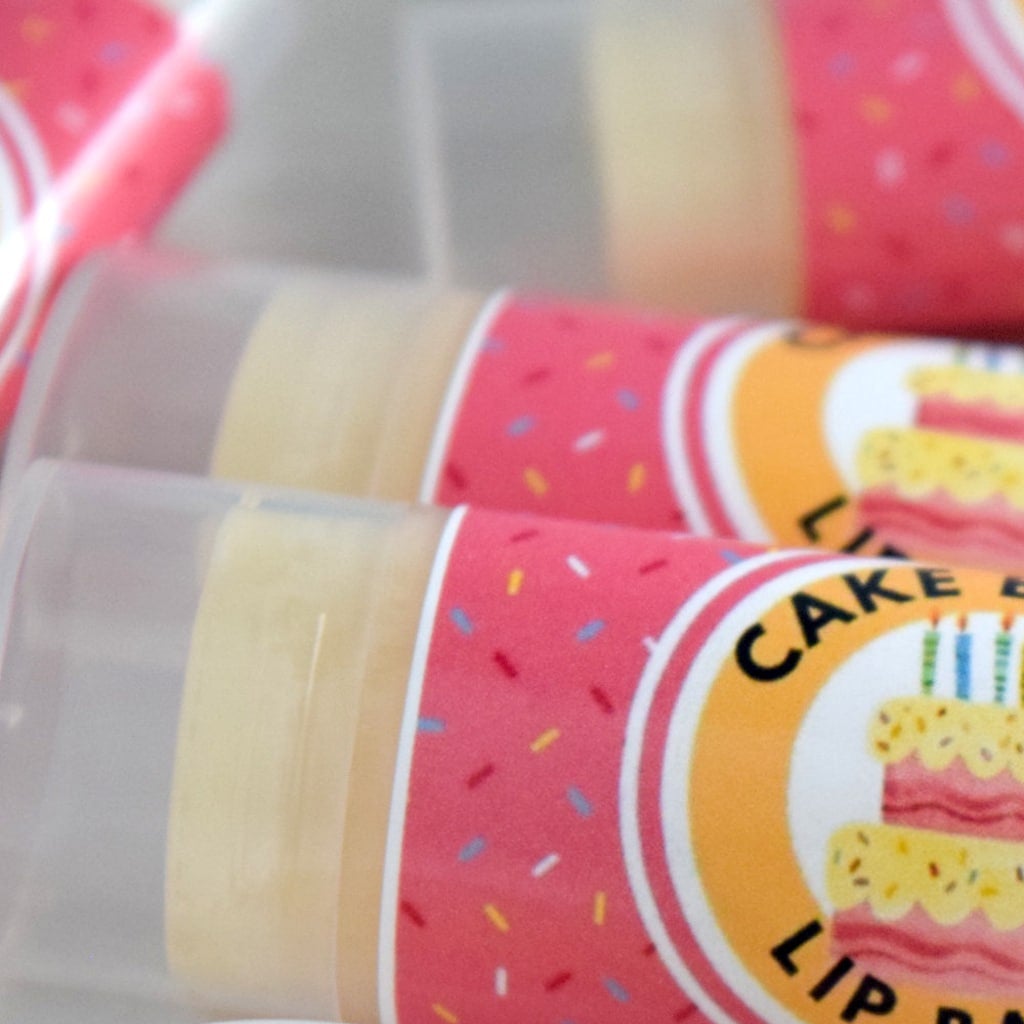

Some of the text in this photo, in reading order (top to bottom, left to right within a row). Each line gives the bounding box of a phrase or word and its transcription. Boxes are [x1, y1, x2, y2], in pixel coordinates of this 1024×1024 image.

[798, 496, 912, 559] LI
[734, 567, 961, 683] CAKE
[770, 919, 898, 1024] LIP
